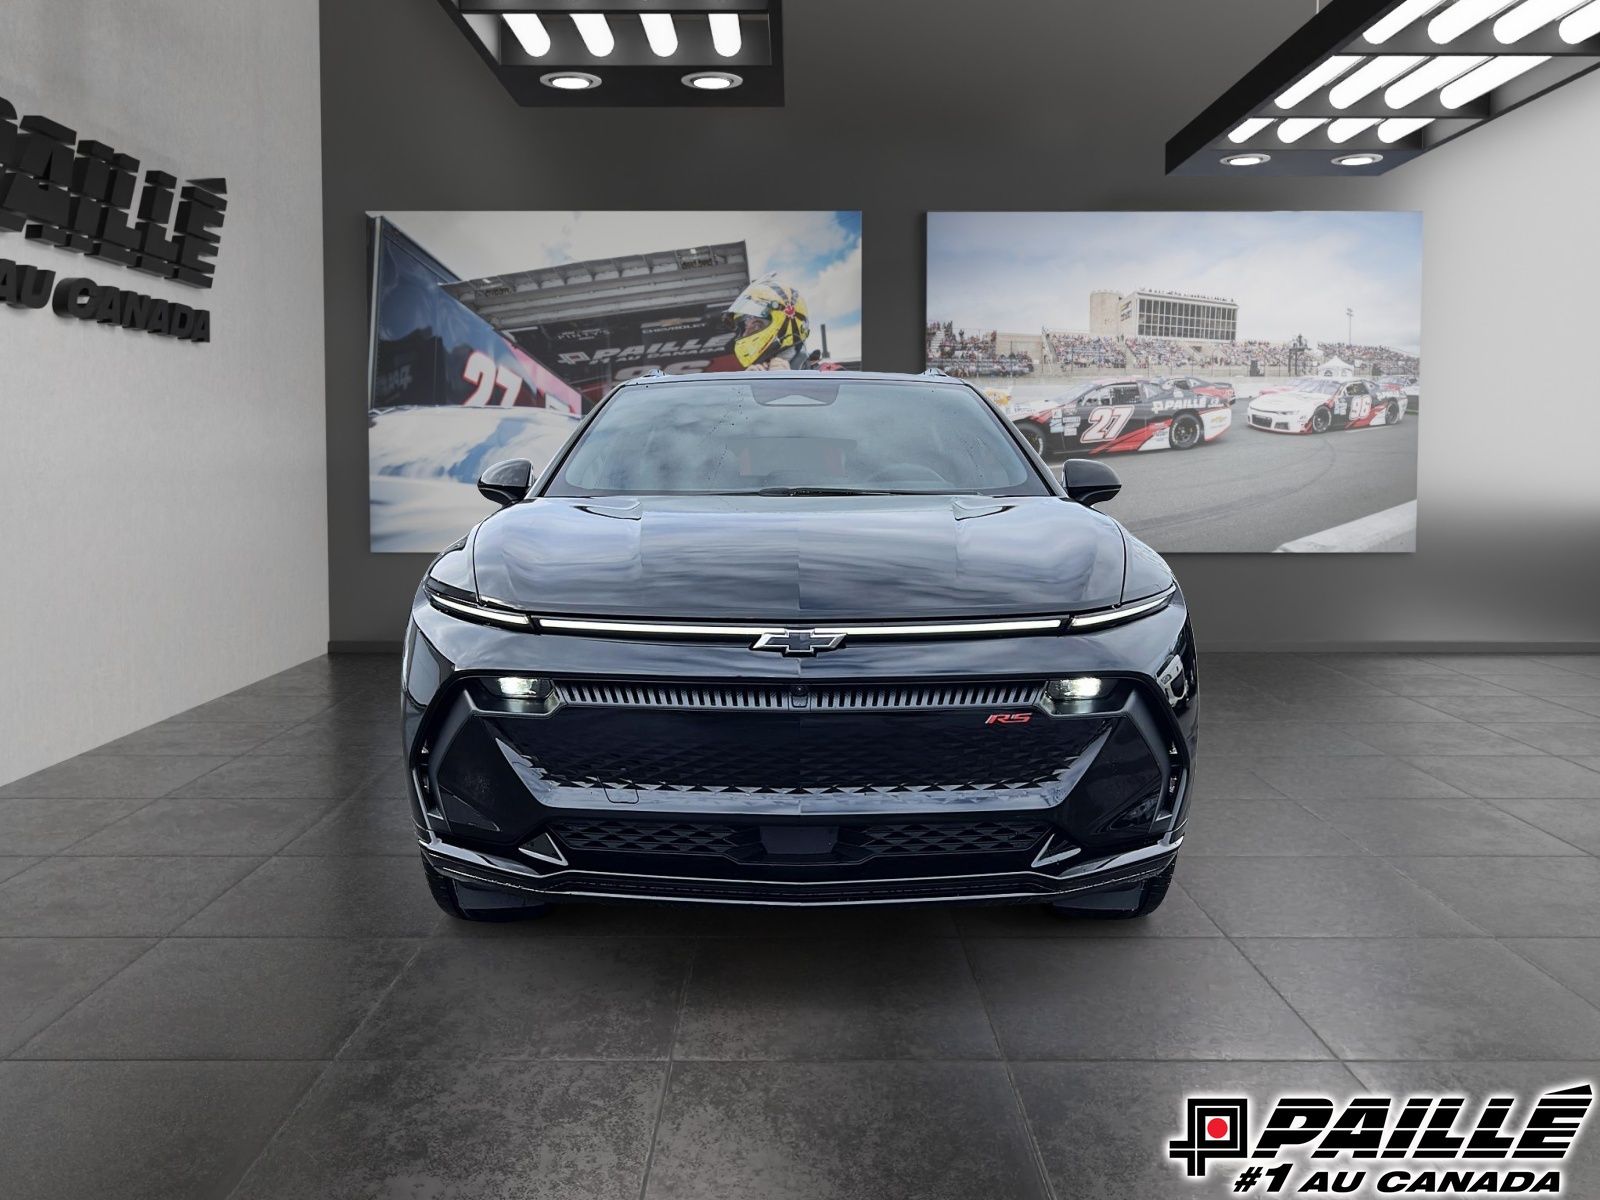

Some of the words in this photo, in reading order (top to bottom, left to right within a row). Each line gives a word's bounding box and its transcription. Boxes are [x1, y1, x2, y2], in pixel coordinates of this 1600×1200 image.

[52, 277, 210, 343] CANADA
[462, 350, 523, 408] 27
[1080, 404, 1135, 443] 27
[985, 712, 1033, 724] RS
